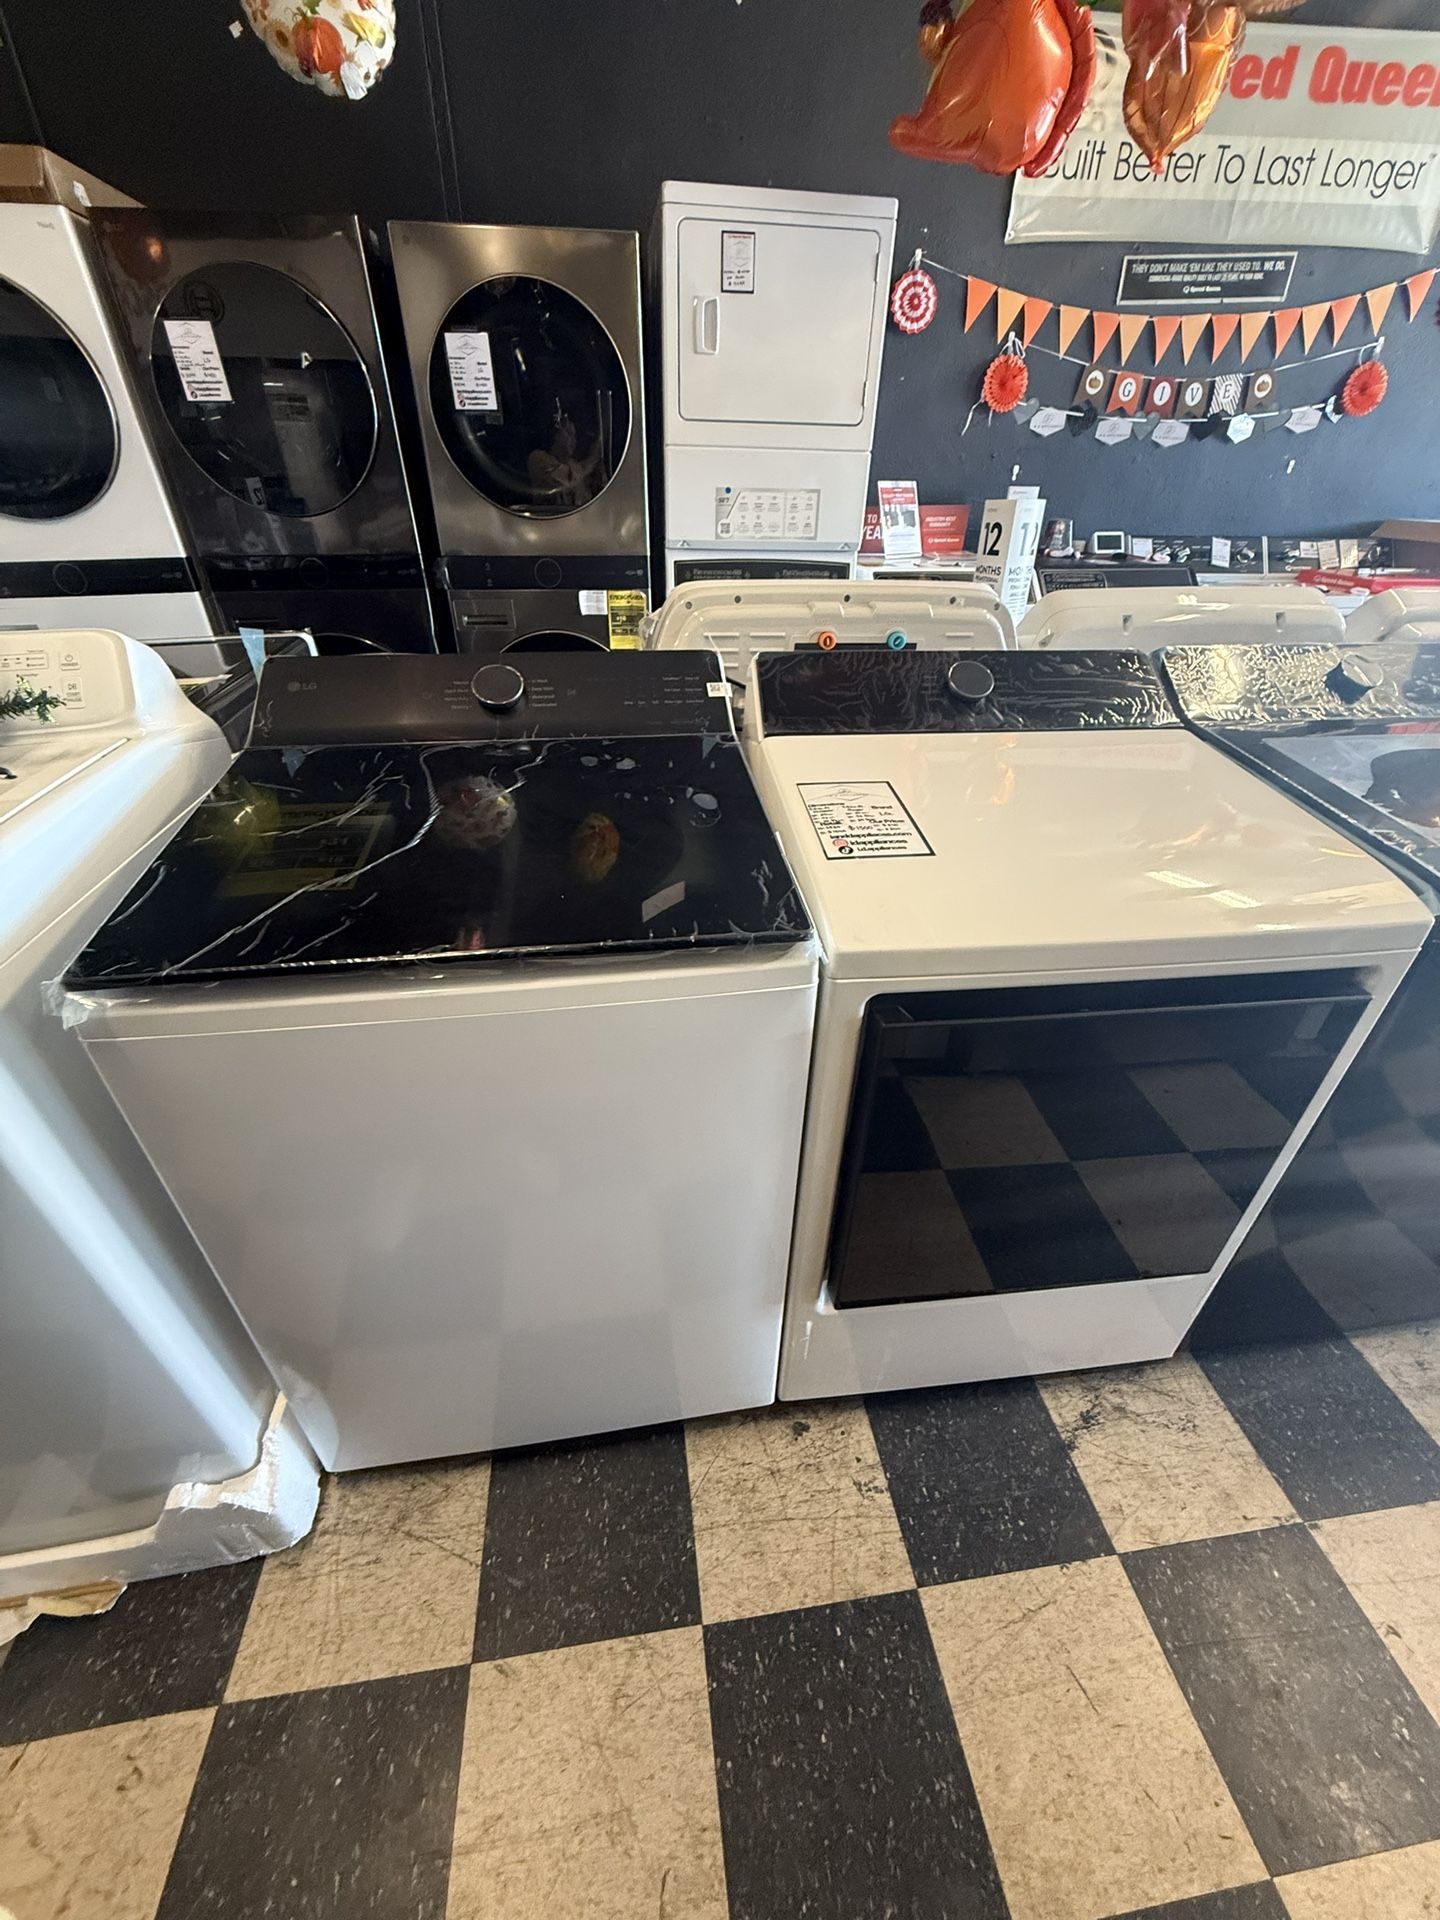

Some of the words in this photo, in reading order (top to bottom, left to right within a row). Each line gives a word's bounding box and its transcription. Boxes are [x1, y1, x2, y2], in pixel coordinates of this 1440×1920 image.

[1308, 45, 1440, 107] Quee
[1113, 141, 1206, 183] Beter
[1214, 145, 1245, 184] To
[1254, 146, 1316, 186] Last
[1320, 148, 1427, 198] Longer
[1132, 263, 1149, 274] THEY
[1149, 263, 1169, 273] DON'T
[1169, 262, 1189, 272] MAKE
[1201, 262, 1216, 272] LIKE
[1216, 261, 1233, 272] THEY
[1233, 261, 1251, 271] USED
[1263, 260, 1275, 271] WE
[983, 521, 1002, 556] 12
[976, 565, 1001, 576] MONTHS
[303, 682, 317, 690] LG
